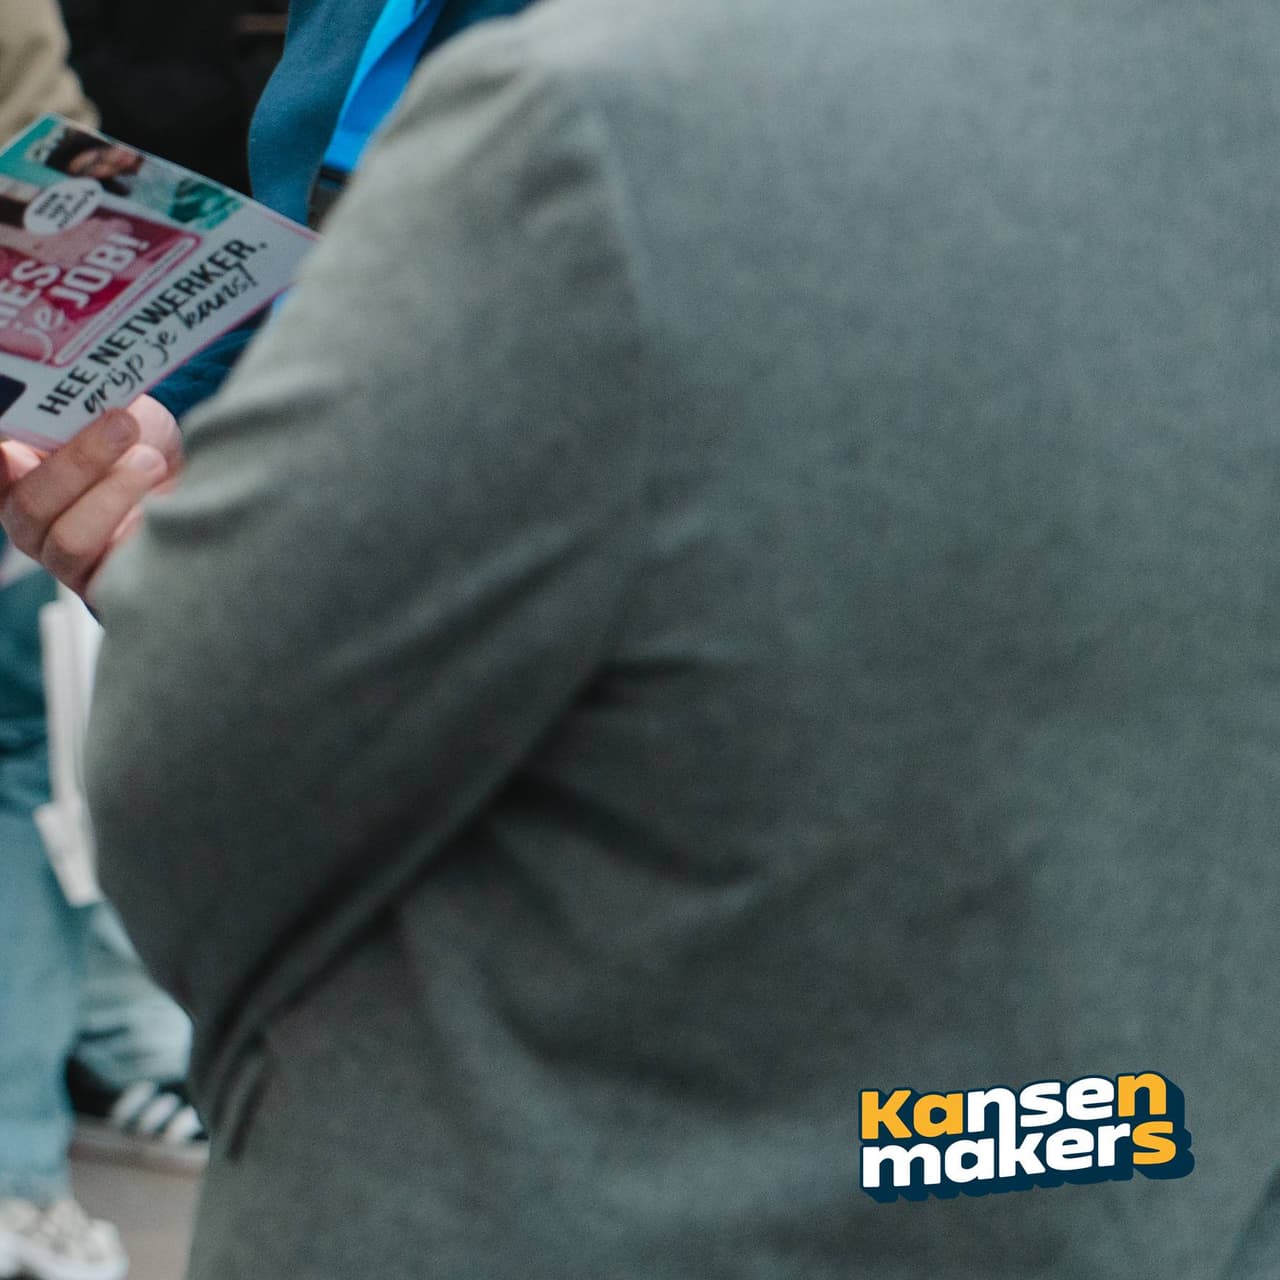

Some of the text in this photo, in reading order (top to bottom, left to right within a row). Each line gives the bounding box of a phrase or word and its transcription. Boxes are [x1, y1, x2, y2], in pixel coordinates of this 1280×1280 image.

[14, 304, 66, 363] je
[50, 232, 151, 310] JOB!
[81, 353, 145, 416] grijp
[145, 329, 178, 368] je
[175, 262, 259, 330] kans!
[37, 365, 98, 416] HEE
